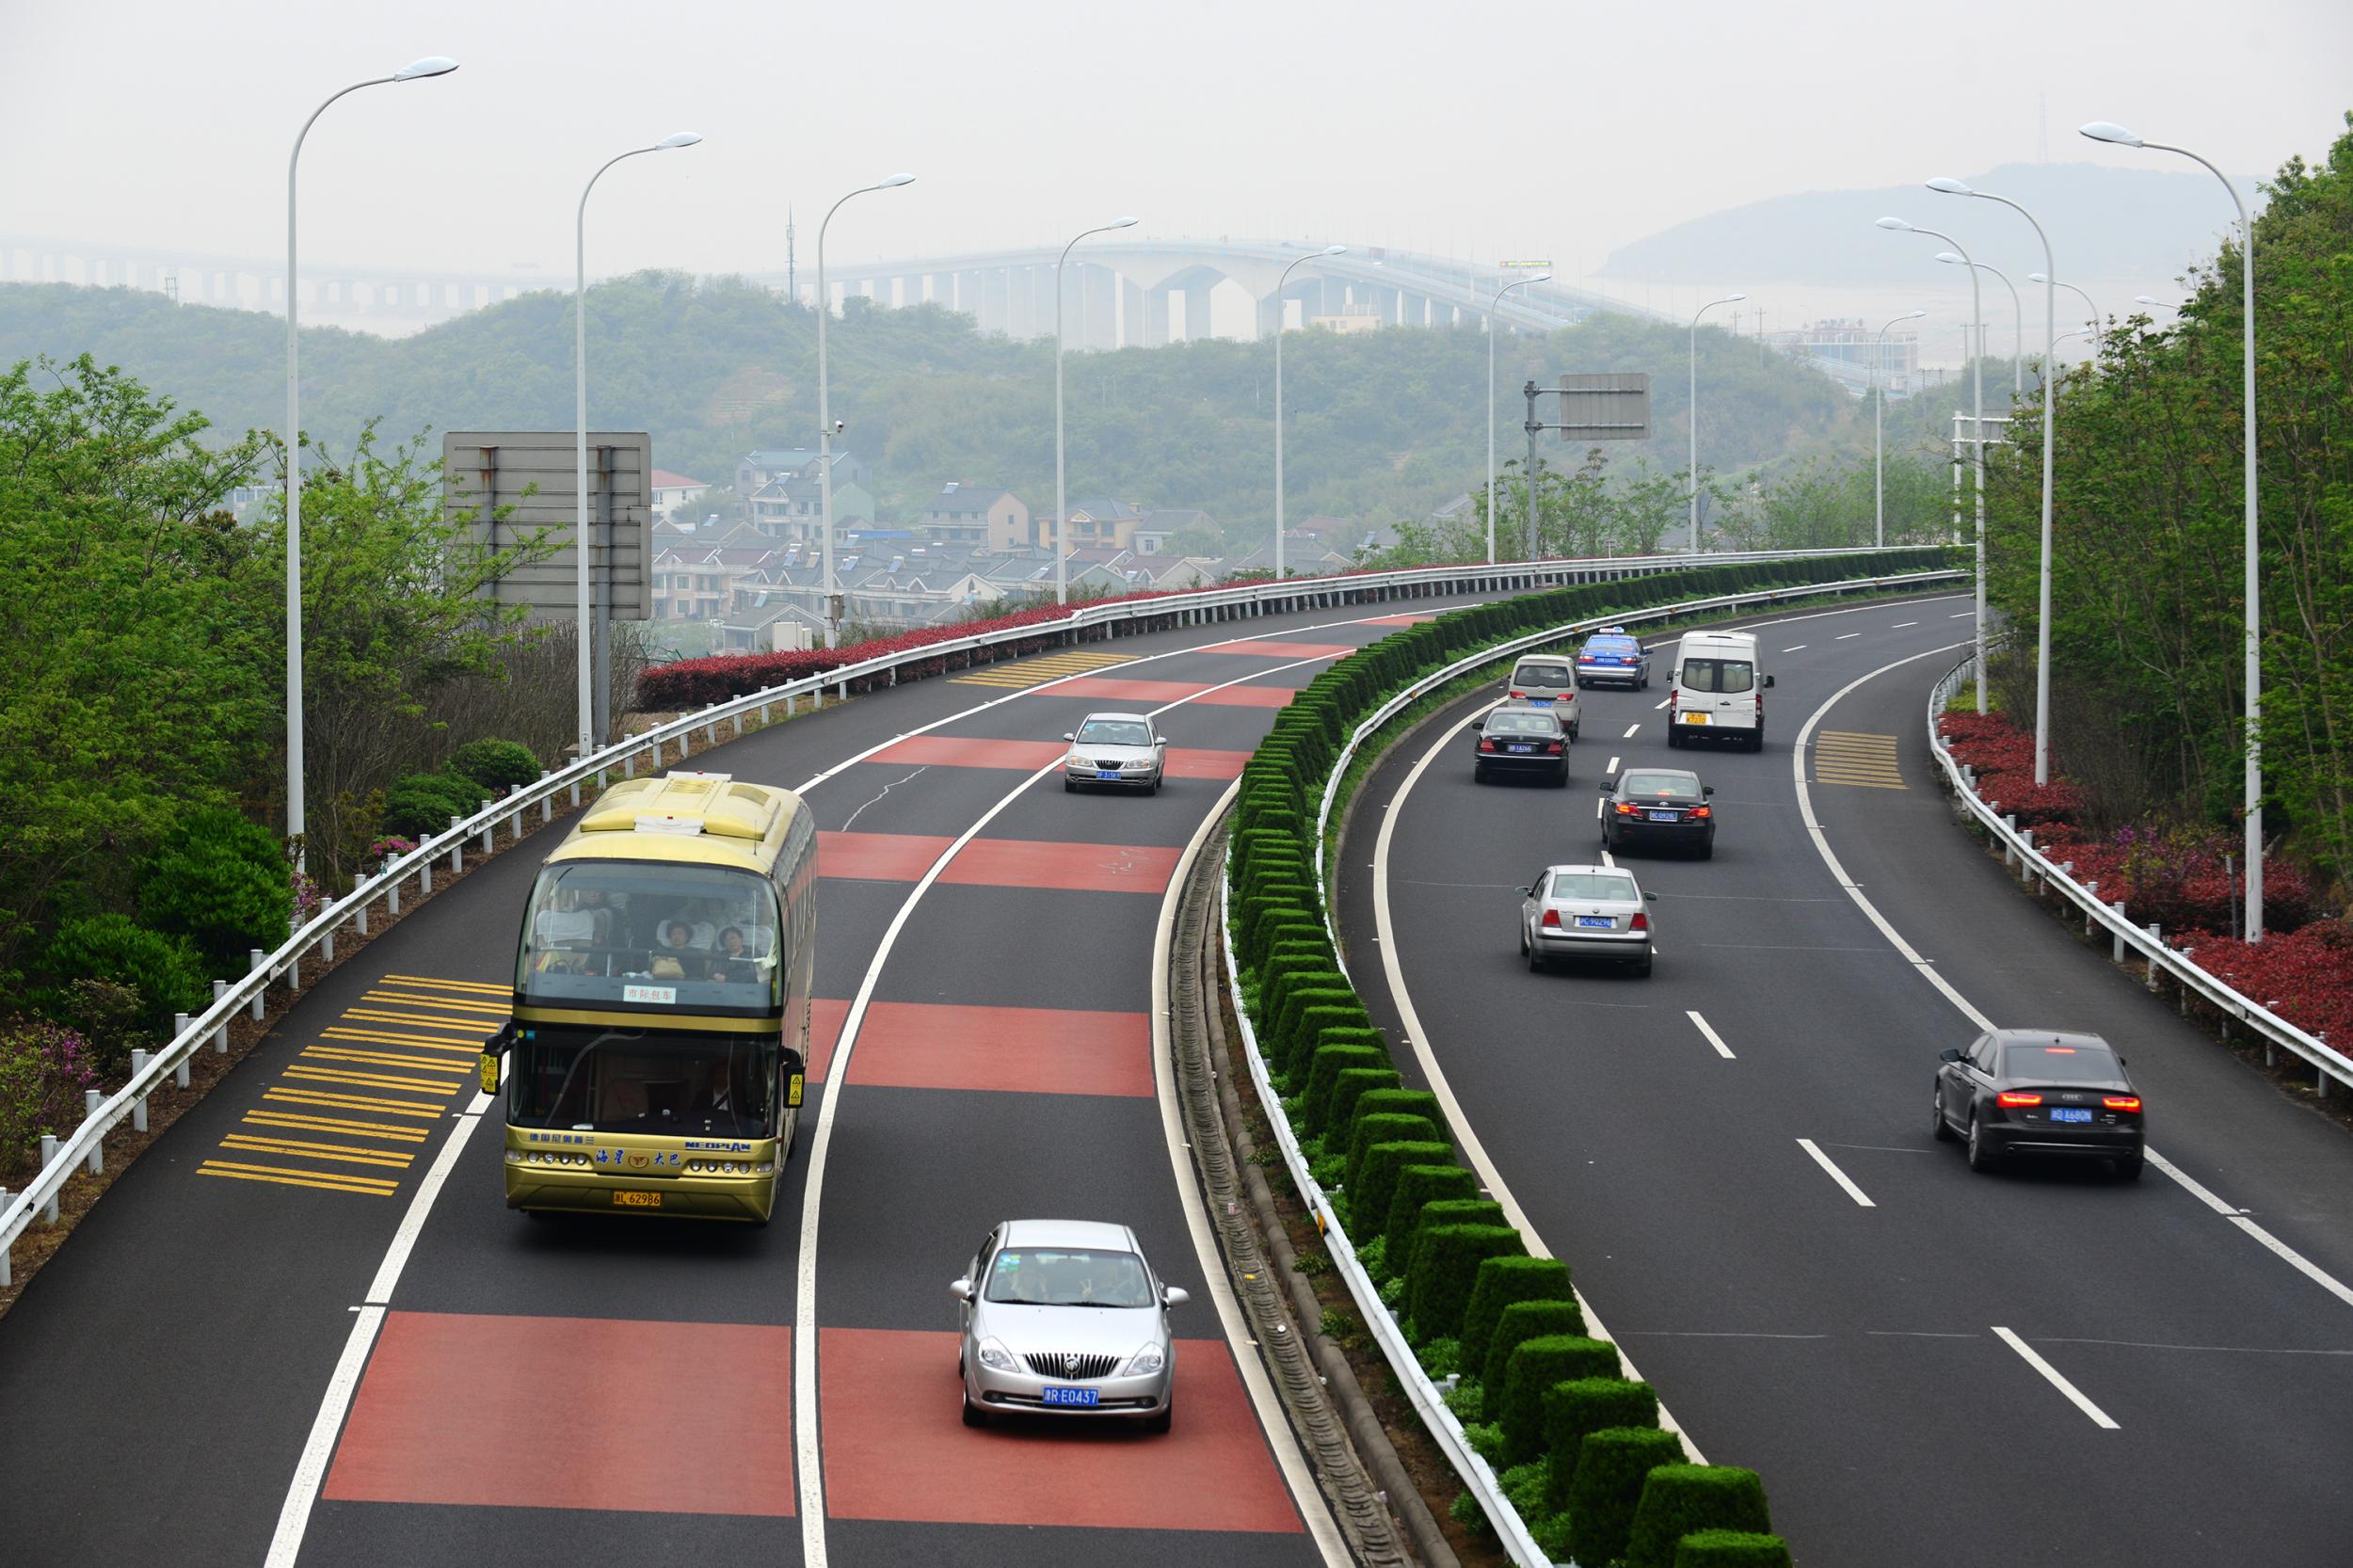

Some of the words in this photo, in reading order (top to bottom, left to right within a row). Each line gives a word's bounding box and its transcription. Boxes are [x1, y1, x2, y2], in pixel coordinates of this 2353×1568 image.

[684, 1142, 751, 1152] NEOPLAN
[595, 1149, 624, 1164] 海星
[653, 1151, 680, 1166] 大巴
